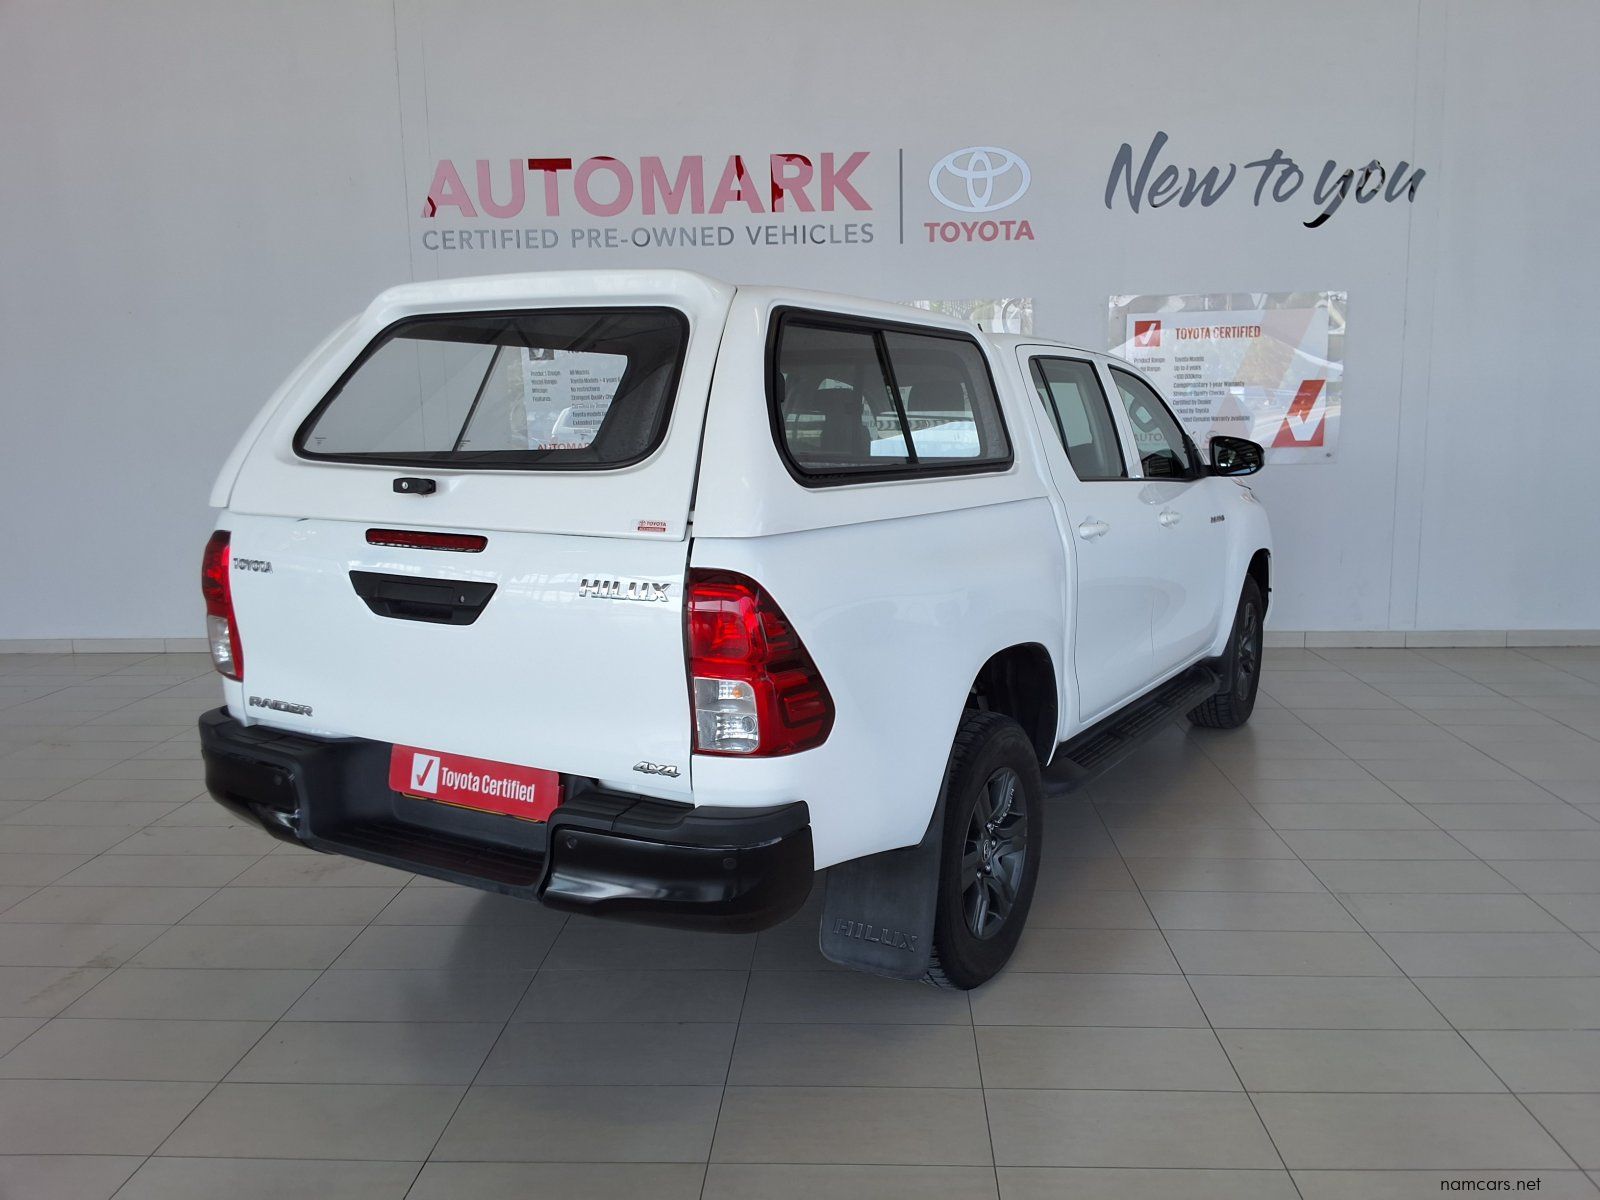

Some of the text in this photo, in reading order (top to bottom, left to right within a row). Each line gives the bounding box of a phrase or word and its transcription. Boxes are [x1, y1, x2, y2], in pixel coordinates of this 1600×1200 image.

[420, 151, 873, 219] AUTOMARK
[1104, 131, 1426, 229] New to you
[422, 223, 874, 251] CERTIFIED PRE-OWNED VEHICLES
[924, 220, 1035, 243] TOYOTA
[1175, 325, 1261, 340] TOYOTA CERTIFIED
[233, 557, 274, 574] TOYOTA
[578, 578, 672, 603] HILUX
[248, 695, 314, 718] RAIDER
[441, 767, 535, 803] Toyota Certified
[833, 918, 918, 952] HILUX
